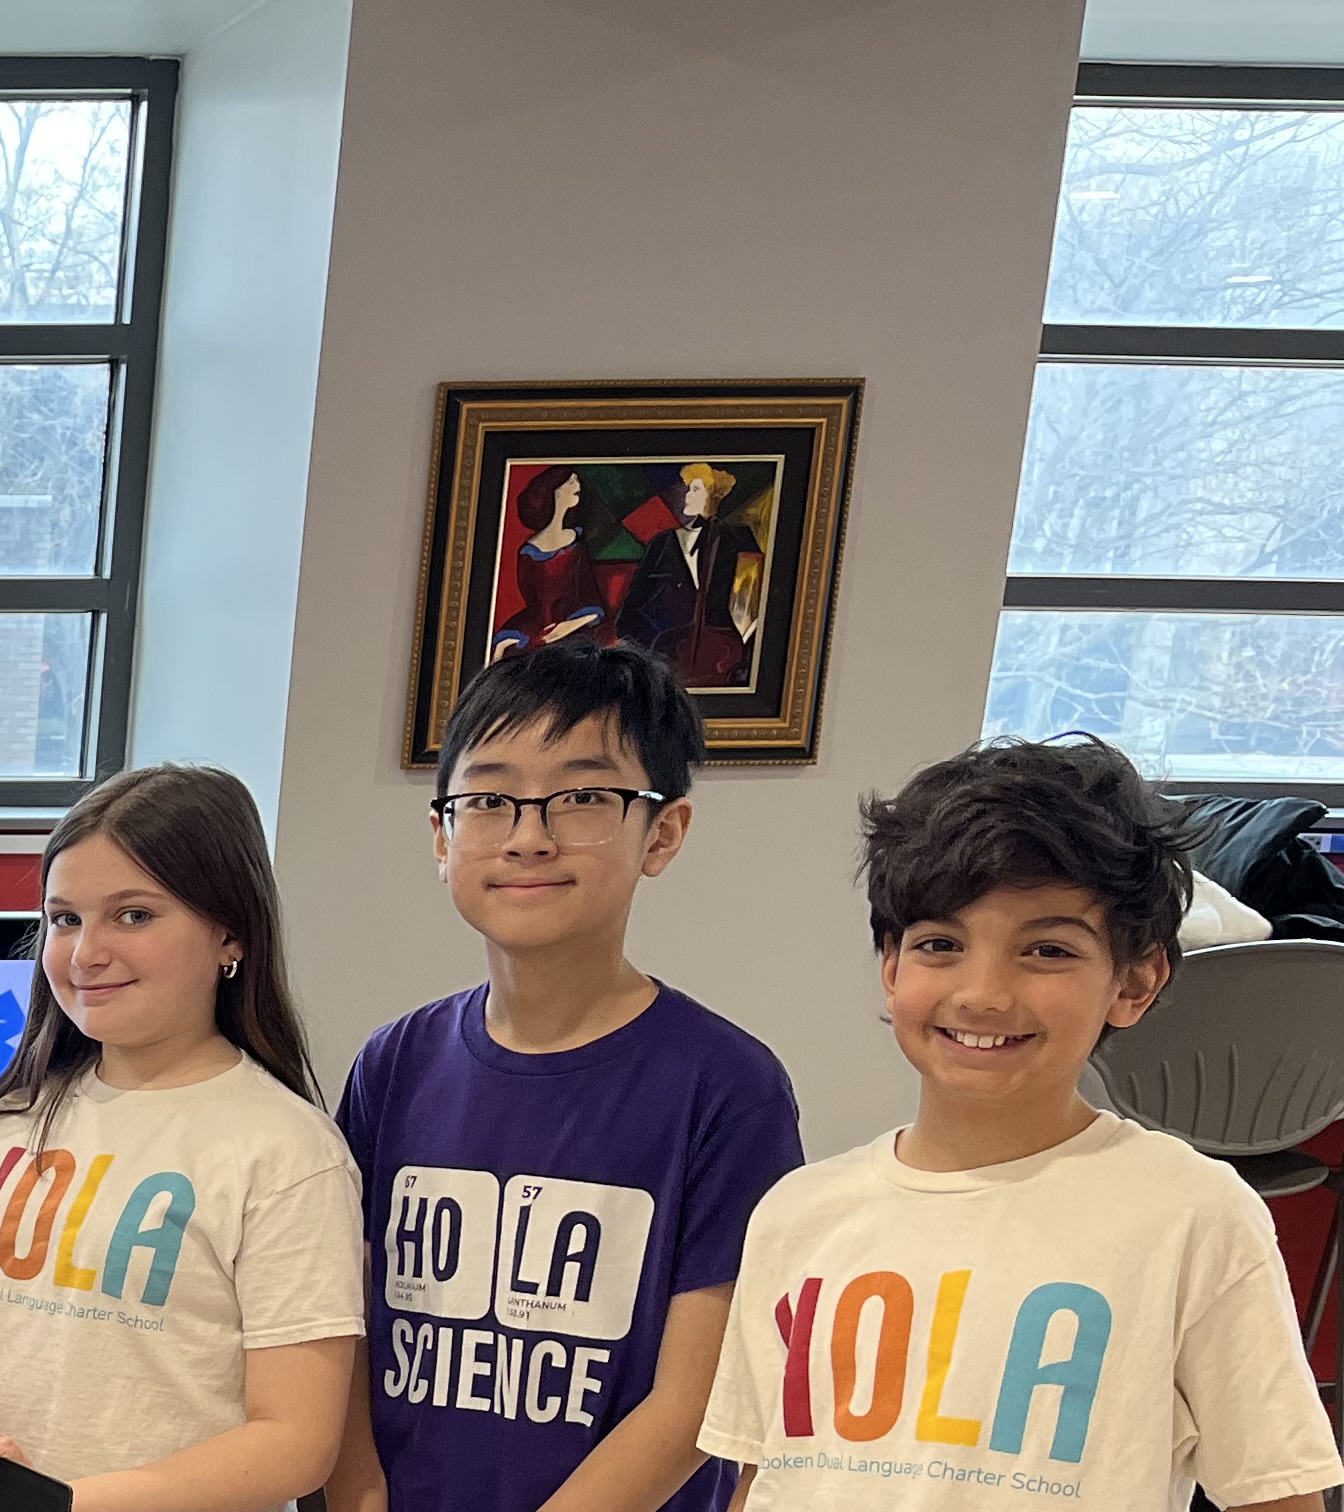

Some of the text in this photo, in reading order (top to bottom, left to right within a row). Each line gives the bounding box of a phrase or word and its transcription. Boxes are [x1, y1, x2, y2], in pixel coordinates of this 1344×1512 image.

[521, 1185, 543, 1200] 57
[396, 1196, 602, 1303] HO LA
[7, 1288, 64, 1315] Language
[116, 1312, 165, 1332] School
[384, 1318, 612, 1428] SCIENCE
[761, 1453, 813, 1470] boken
[816, 1452, 843, 1471] Dual
[927, 1460, 1007, 1488] Charter
[1010, 1472, 1082, 1499] School
